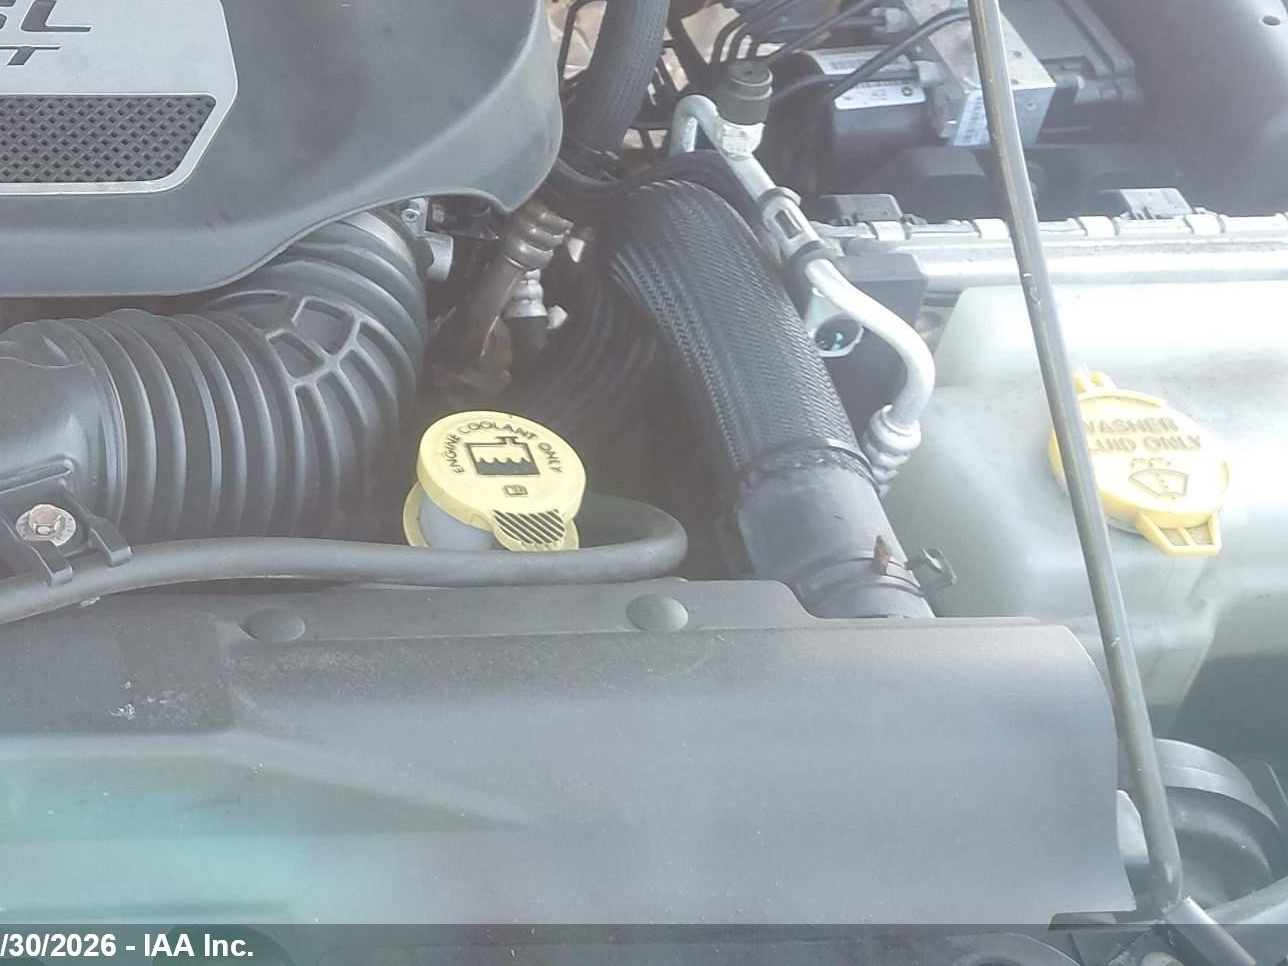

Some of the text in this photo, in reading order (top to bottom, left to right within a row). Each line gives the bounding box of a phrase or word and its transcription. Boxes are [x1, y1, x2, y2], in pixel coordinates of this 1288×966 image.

[441, 420, 563, 475] ENGINE COOLANT ONLY
[1088, 435, 1202, 452] UID ONLY
